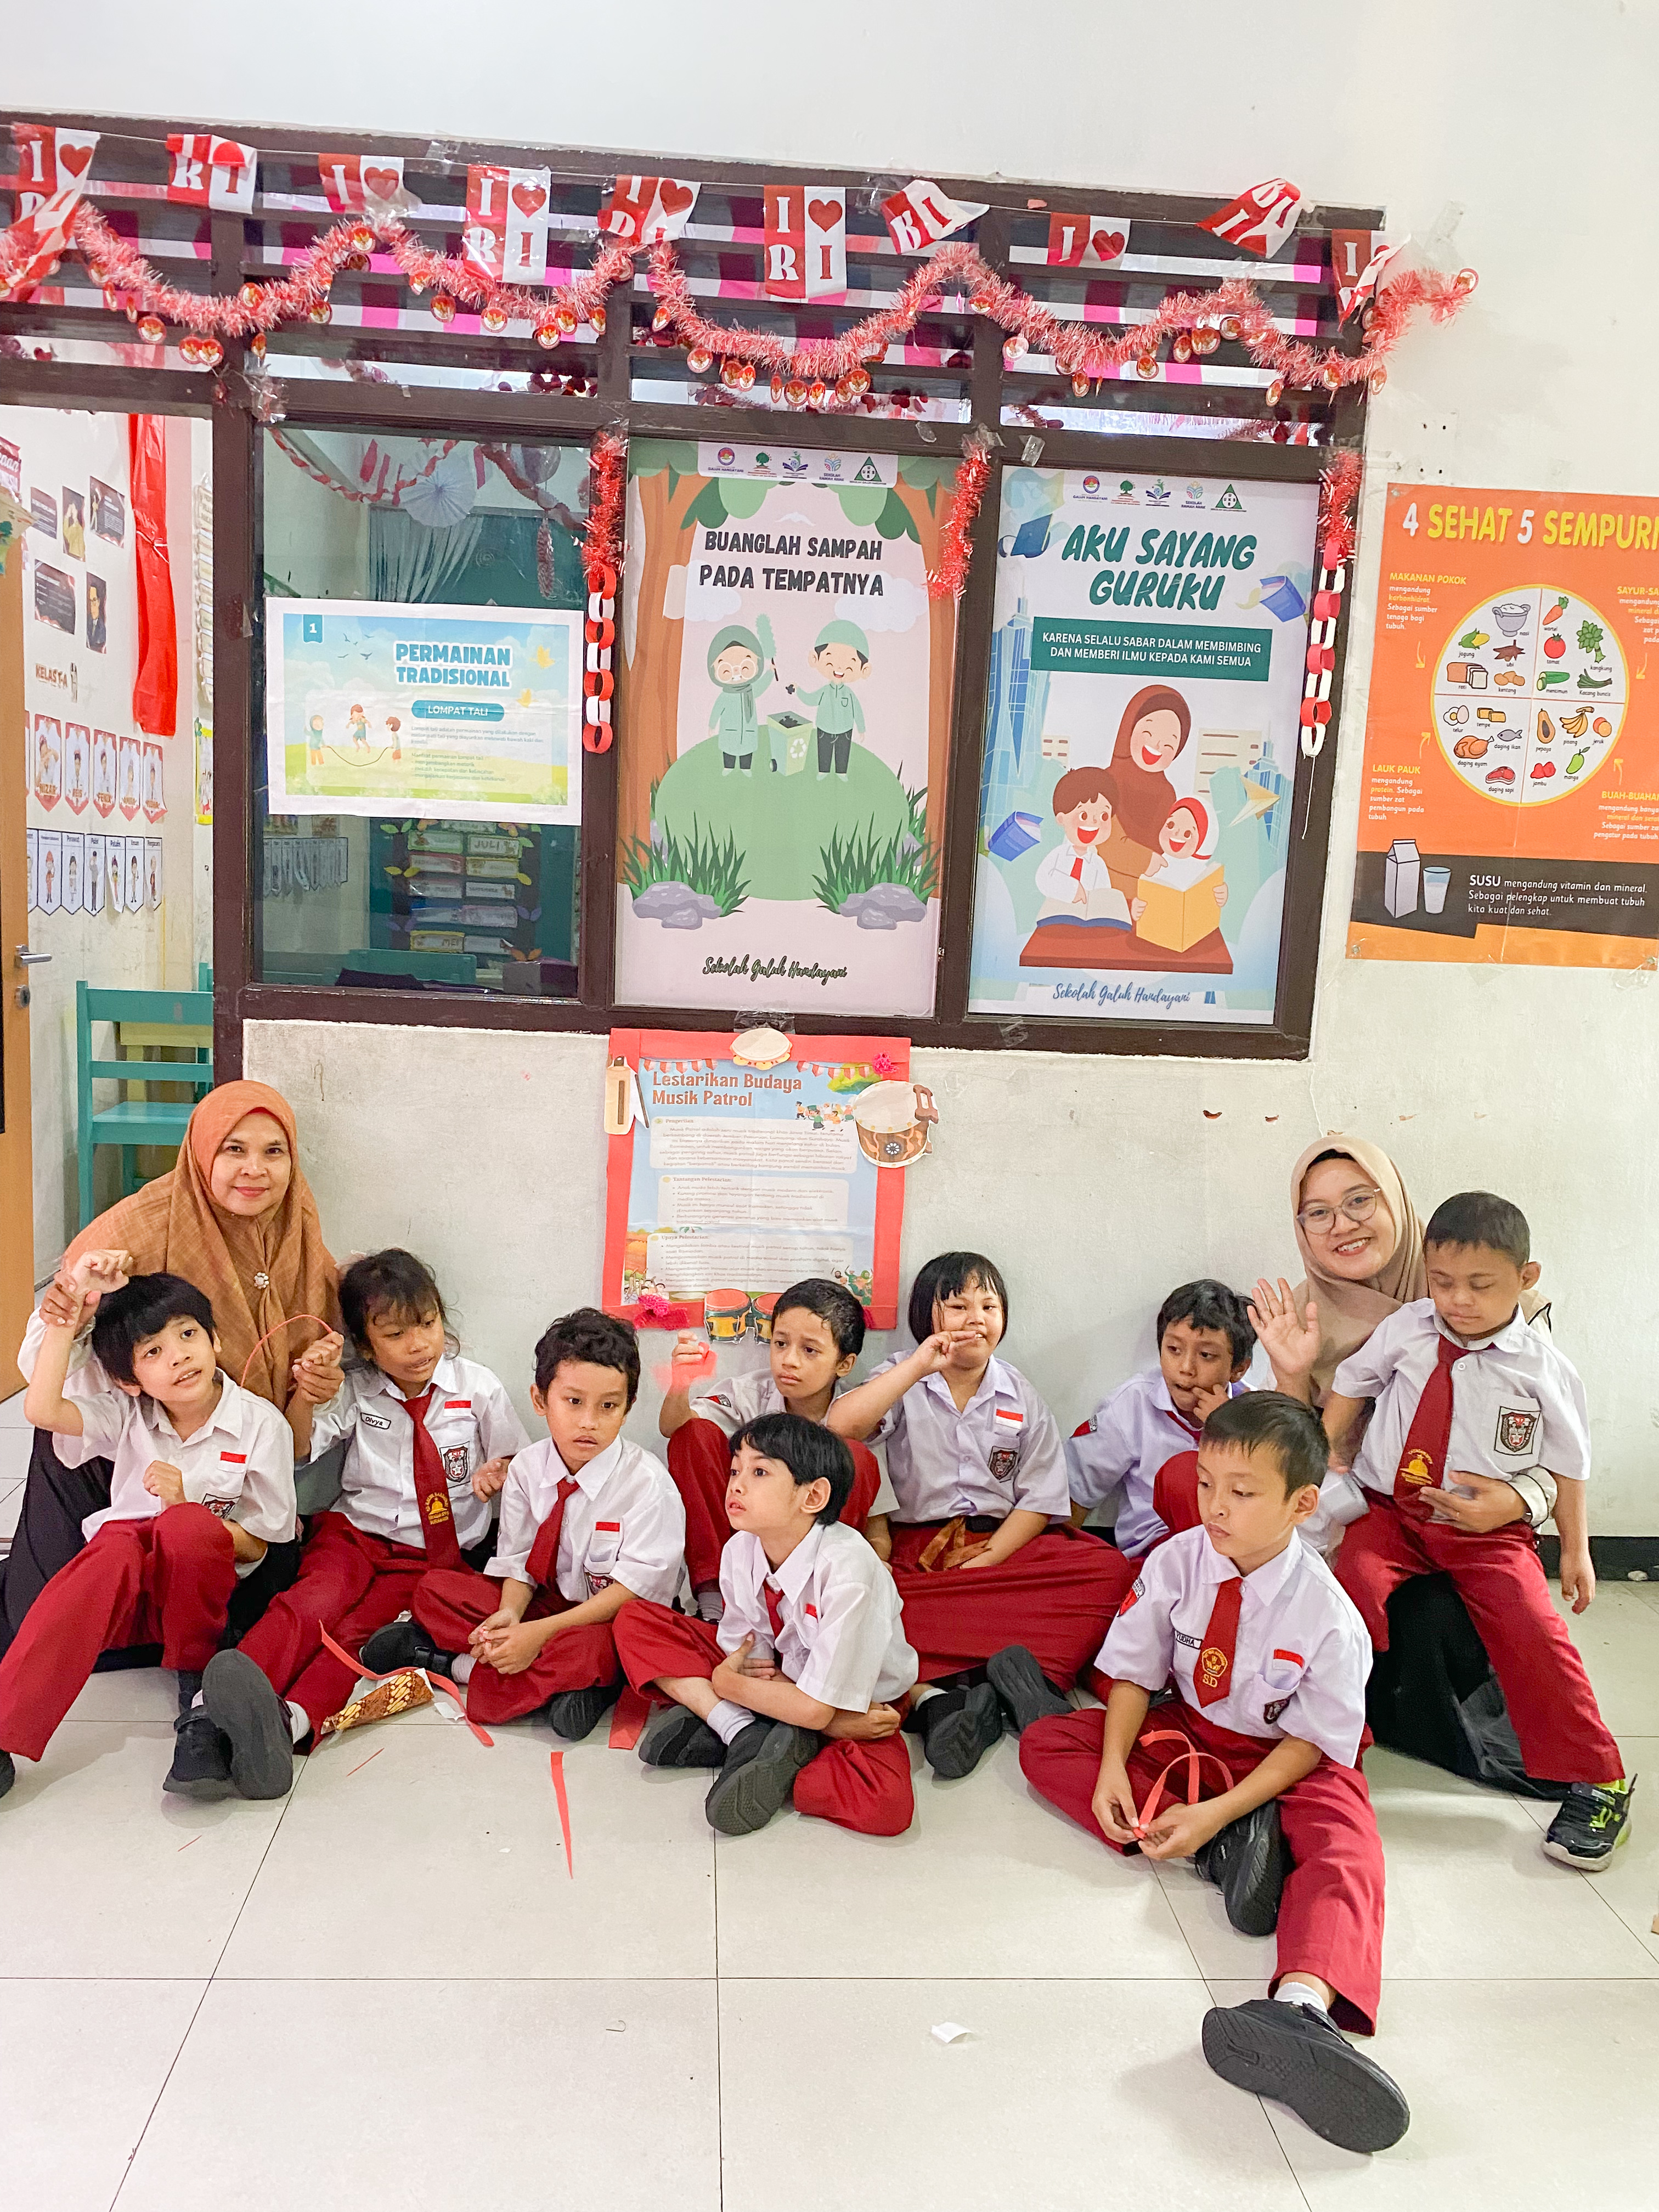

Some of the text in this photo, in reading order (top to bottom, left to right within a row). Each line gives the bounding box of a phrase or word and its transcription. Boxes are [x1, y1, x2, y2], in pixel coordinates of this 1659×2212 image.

[1402, 503, 1419, 537] 4
[1427, 504, 1513, 543] SEHAT
[1517, 509, 1534, 544] 5
[704, 531, 882, 560] BUANGLAH SAMPAH
[1062, 524, 1257, 571] AKU SAYANG
[699, 565, 883, 596] PADA TEMPATNYA
[1390, 573, 1466, 585] MAKANAN POKOK
[1089, 570, 1226, 611] GURUKU
[1389, 586, 1431, 596] mengandung
[1387, 603, 1413, 613] Sebagai
[1387, 614, 1424, 624] tenaga bagi
[309, 623, 317, 634] 1
[1042, 632, 1261, 653] KARENA SELALU SABAR DALAM MEMBIMBING
[396, 644, 510, 665] PERMAINAN
[1050, 646, 1251, 667] DAN MEMBERI ILMU KEPADA KAMI SEMUA
[397, 667, 510, 687] TRADISIONAL
[428, 706, 488, 716] LOMPAT TALI
[1373, 764, 1421, 774] LAUK PAUK
[1372, 777, 1413, 786] mengandung
[1397, 787, 1423, 796] Sebagai
[1369, 804, 1424, 815] pembangun pada
[1598, 805, 1638, 814] mengandung
[1602, 822, 1626, 831] Sebagai
[474, 840, 500, 850] JULI
[1469, 875, 1647, 893] SUSU mengandung vitamin dan mineral.
[1469, 890, 1645, 907] Sebagai pelengkap untuk membuat tubuh
[1468, 904, 1552, 916] kita kuat dan sehat.
[703, 954, 749, 977] Sekolah
[1053, 980, 1190, 1009] Sekolah Galuh Handayani
[653, 1071, 802, 1093] Lestarikan Budaya
[652, 1090, 752, 1107] Musik Patrol
[365, 1416, 383, 1426] Divya
[1177, 1633, 1195, 1646] YUDHA
[1202, 1673, 1218, 1688] SD
